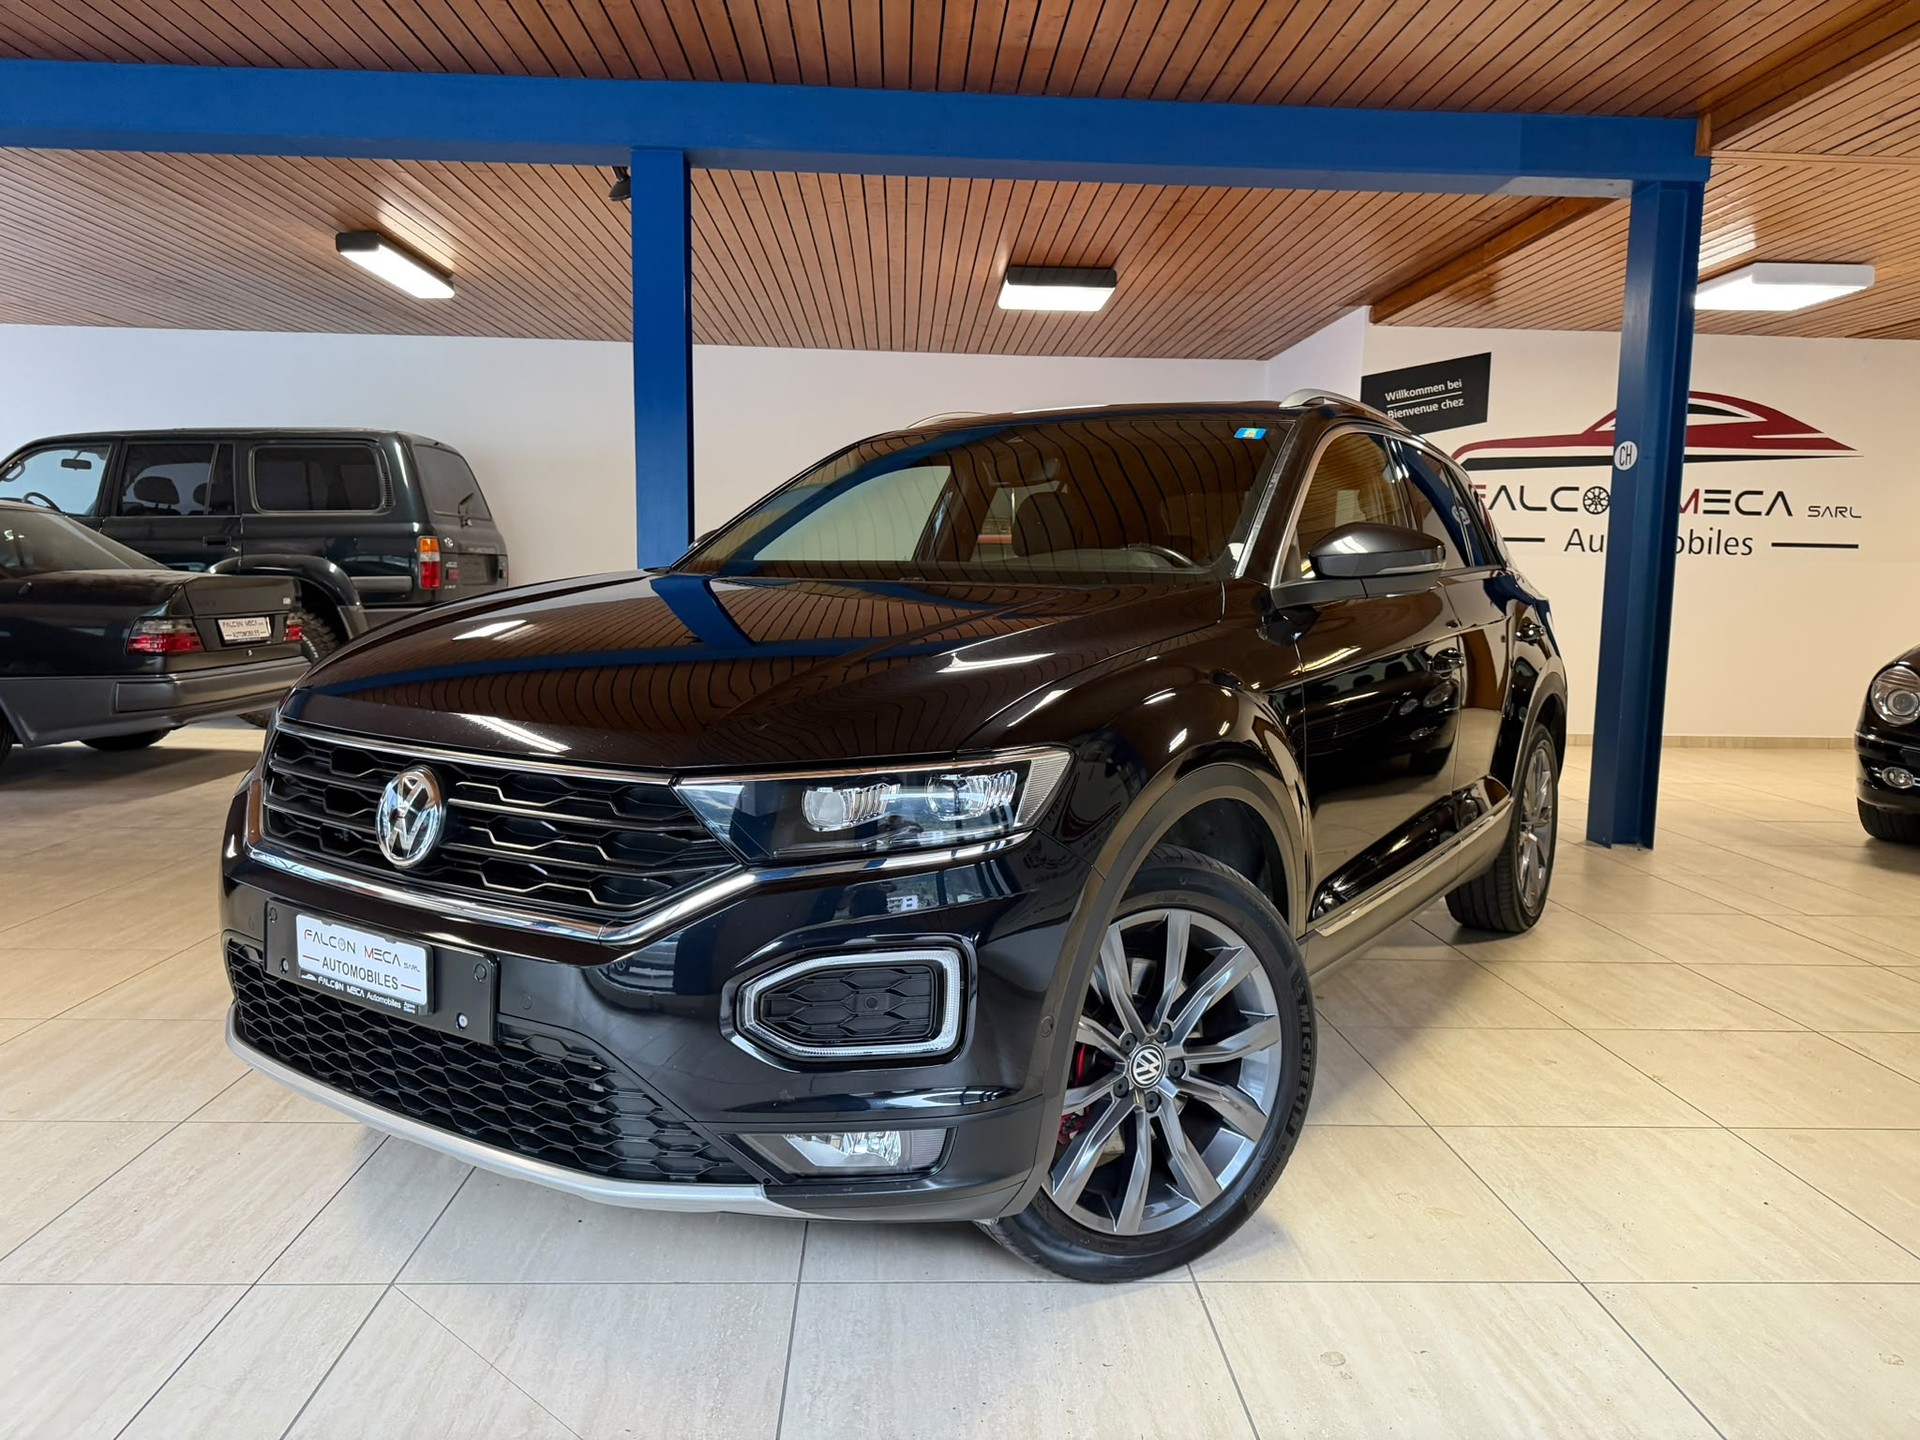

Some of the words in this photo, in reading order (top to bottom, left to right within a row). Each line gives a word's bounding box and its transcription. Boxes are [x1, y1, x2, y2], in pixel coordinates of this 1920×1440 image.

[1385, 384, 1445, 401] Willkommen
[1447, 378, 1463, 390] bei
[1387, 405, 1439, 420] Bienvenue
[1441, 398, 1465, 410] chez
[1619, 446, 1633, 466] CH
[1807, 505, 1862, 518] SARL
[304, 929, 356, 954] FALCON
[364, 945, 401, 967] MECA
[321, 956, 399, 990] AUTOMOBILES
[317, 976, 345, 992] FALCON
[346, 986, 365, 998] MECA
[366, 992, 402, 1009] Automobiles
[1290, 1004, 1312, 1131] MICHELIN
